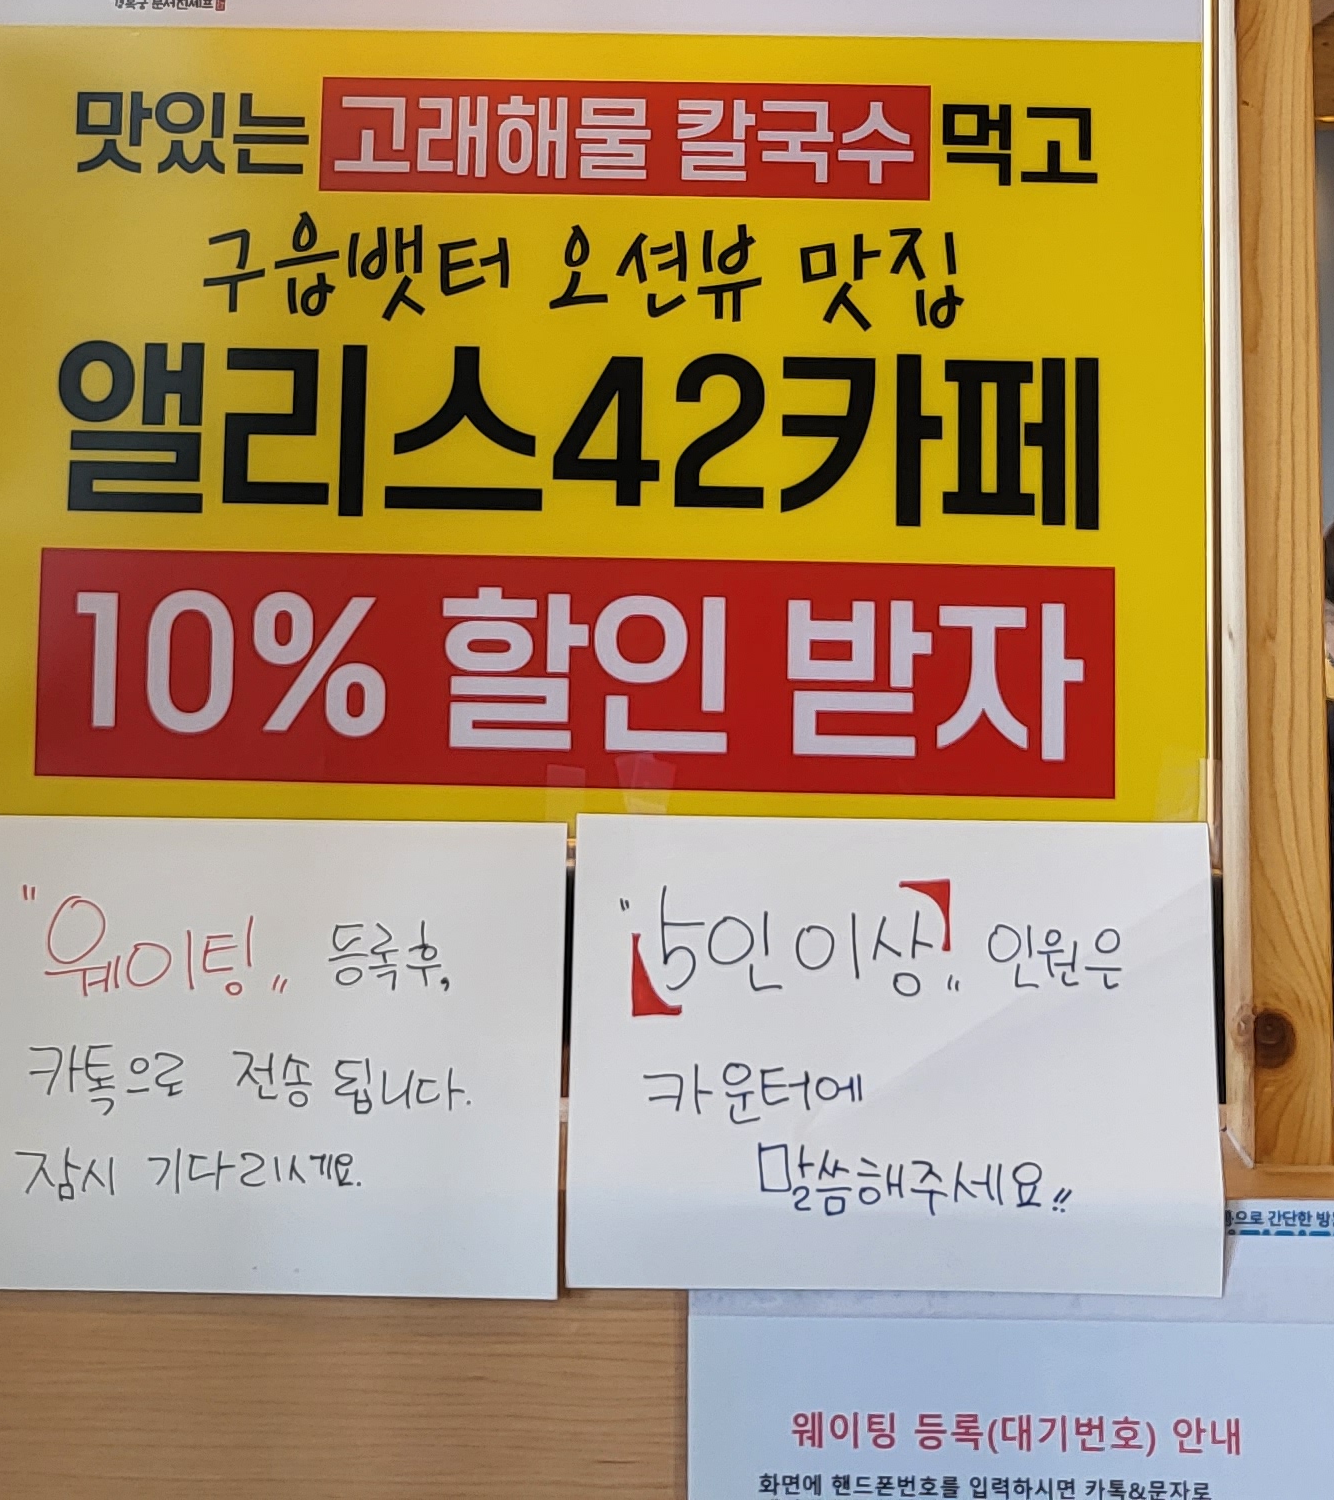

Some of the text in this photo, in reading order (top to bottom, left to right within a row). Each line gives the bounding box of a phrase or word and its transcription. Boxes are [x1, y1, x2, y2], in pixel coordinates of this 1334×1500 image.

[75, 90, 1098, 187] 맛있는 고래해물 칼국수 먹고
[202, 211, 964, 332] 구읍뱃터 오션뷰 맛집
[58, 338, 1101, 532] 앨리스42카페
[75, 587, 1084, 762] 10% 할인 받자
[987, 923, 1122, 991] 인원은
[28, 1044, 185, 1117] 카톡으로
[643, 1061, 864, 1125] 카운터에
[14, 1146, 116, 1202] 잠시
[1268, 1210, 1313, 1227] 간단한
[791, 1411, 1242, 1457] 웨이팅 등록(대기번호) 안내
[757, 1472, 822, 1497] 화면에
[831, 1473, 961, 1499] 핸드폰번호를
[969, 1475, 1076, 1500] 입력하시면
